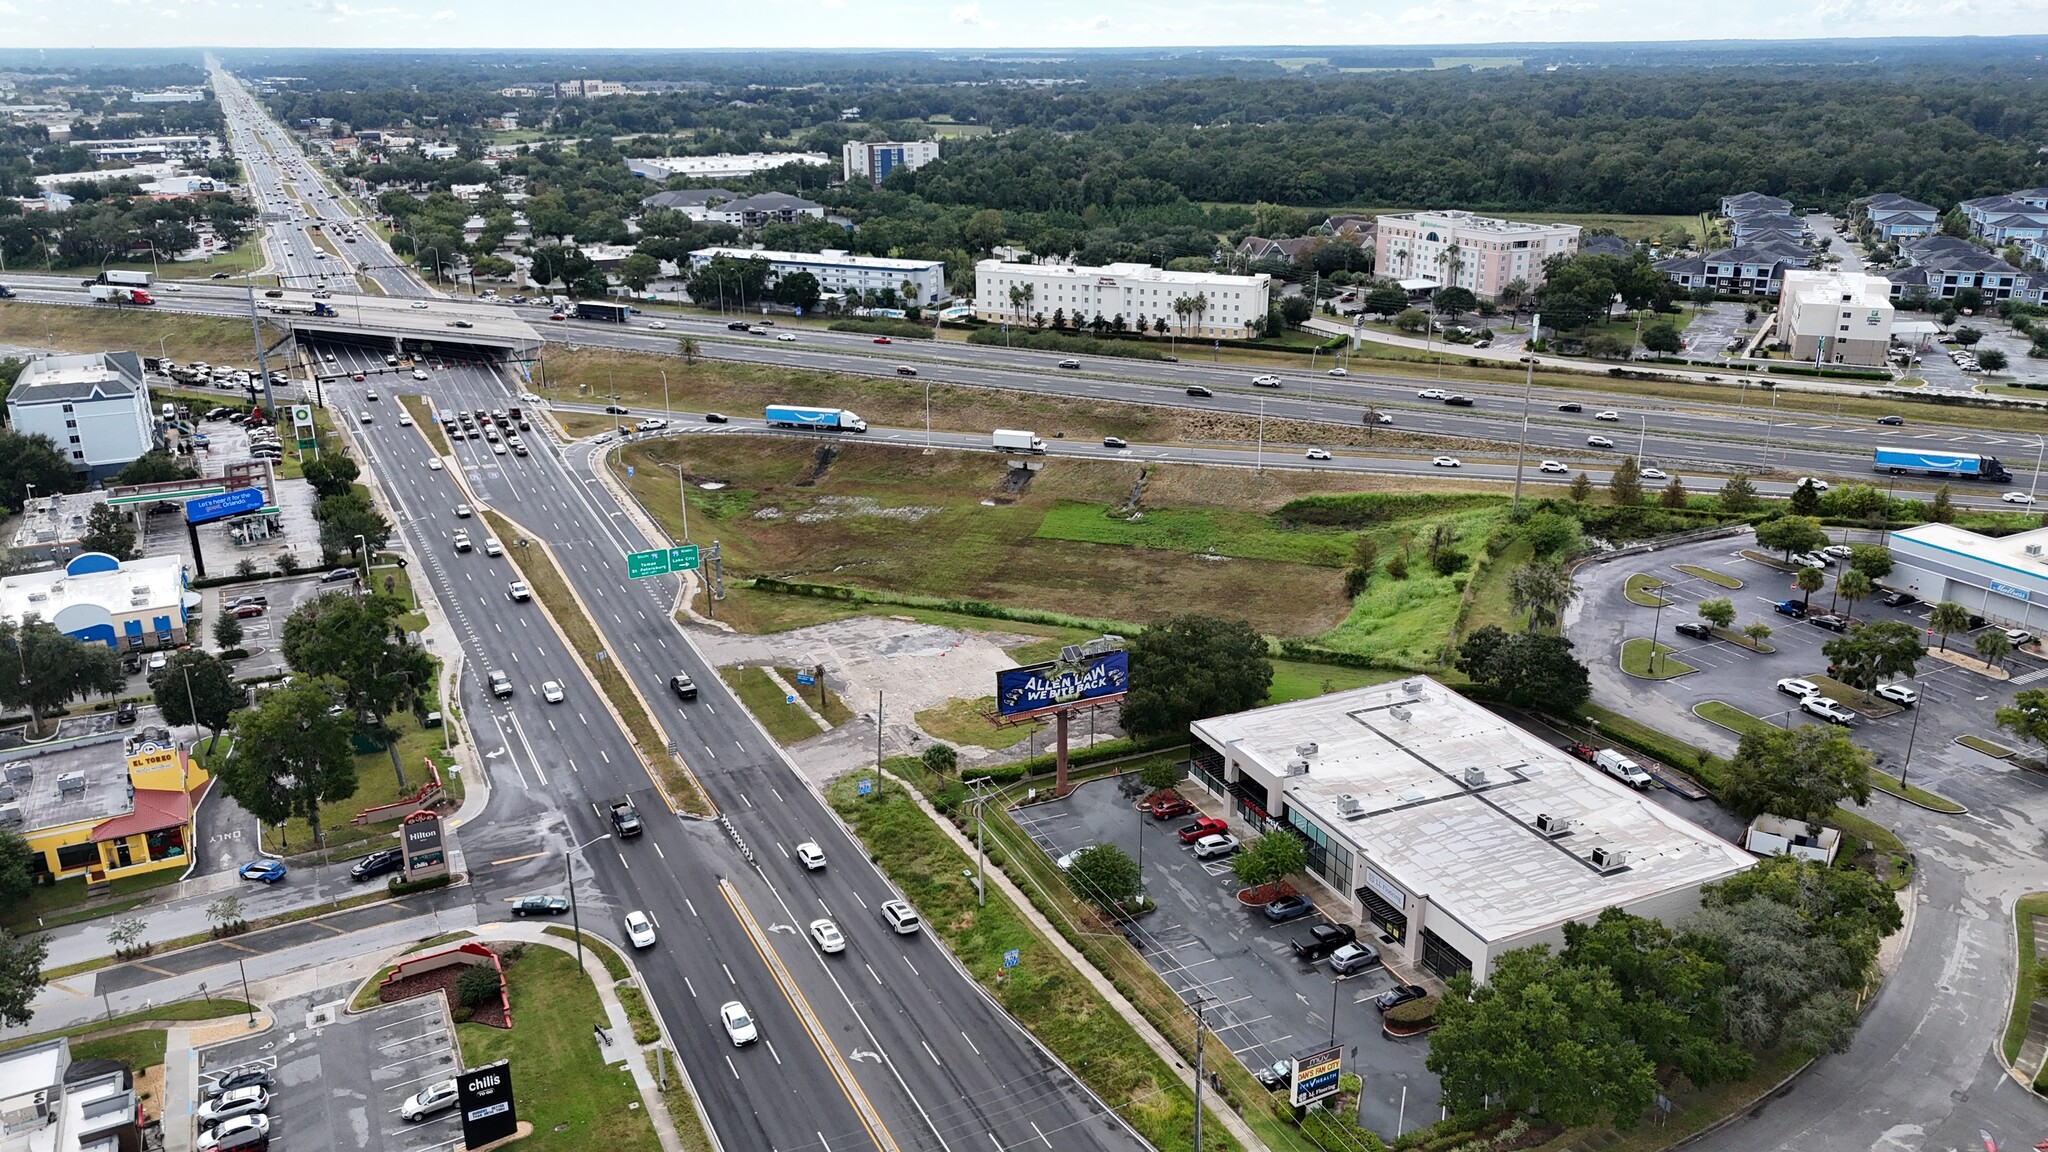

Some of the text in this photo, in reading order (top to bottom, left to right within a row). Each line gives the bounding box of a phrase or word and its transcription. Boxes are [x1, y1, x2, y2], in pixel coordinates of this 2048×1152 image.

[222, 499, 246, 508] Orlando
[1024, 664, 1106, 691] ALLEN LAW
[1027, 678, 1107, 701] WE BITE BACK
[145, 754, 172, 764] TOREO
[209, 830, 241, 843] ONLY
[410, 830, 437, 841] Hilton
[1298, 1061, 1340, 1081] DAN'S FAN CITY
[1315, 1084, 1337, 1095] Flooring
